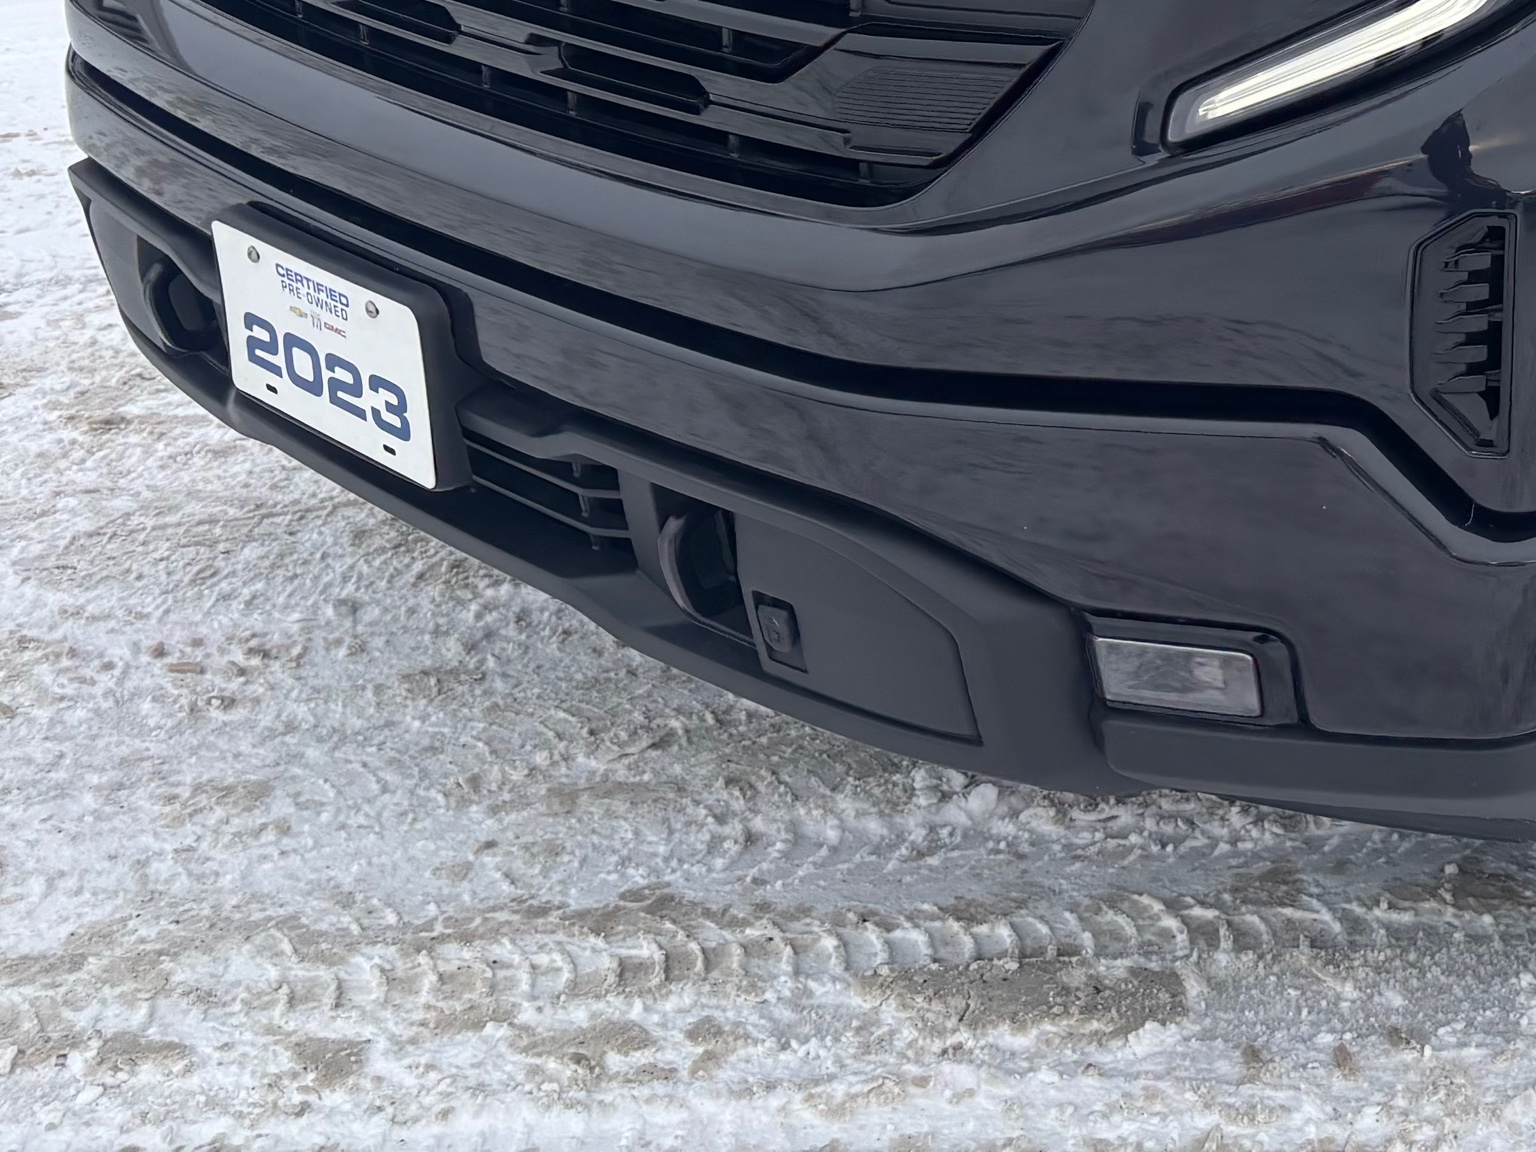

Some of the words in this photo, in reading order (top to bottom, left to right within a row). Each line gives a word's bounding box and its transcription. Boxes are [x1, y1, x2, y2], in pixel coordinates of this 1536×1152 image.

[275, 263, 350, 308] CERTIFIED
[281, 280, 348, 321] PRE-OWNED
[323, 321, 347, 338] GMC
[244, 312, 411, 442] 2023
